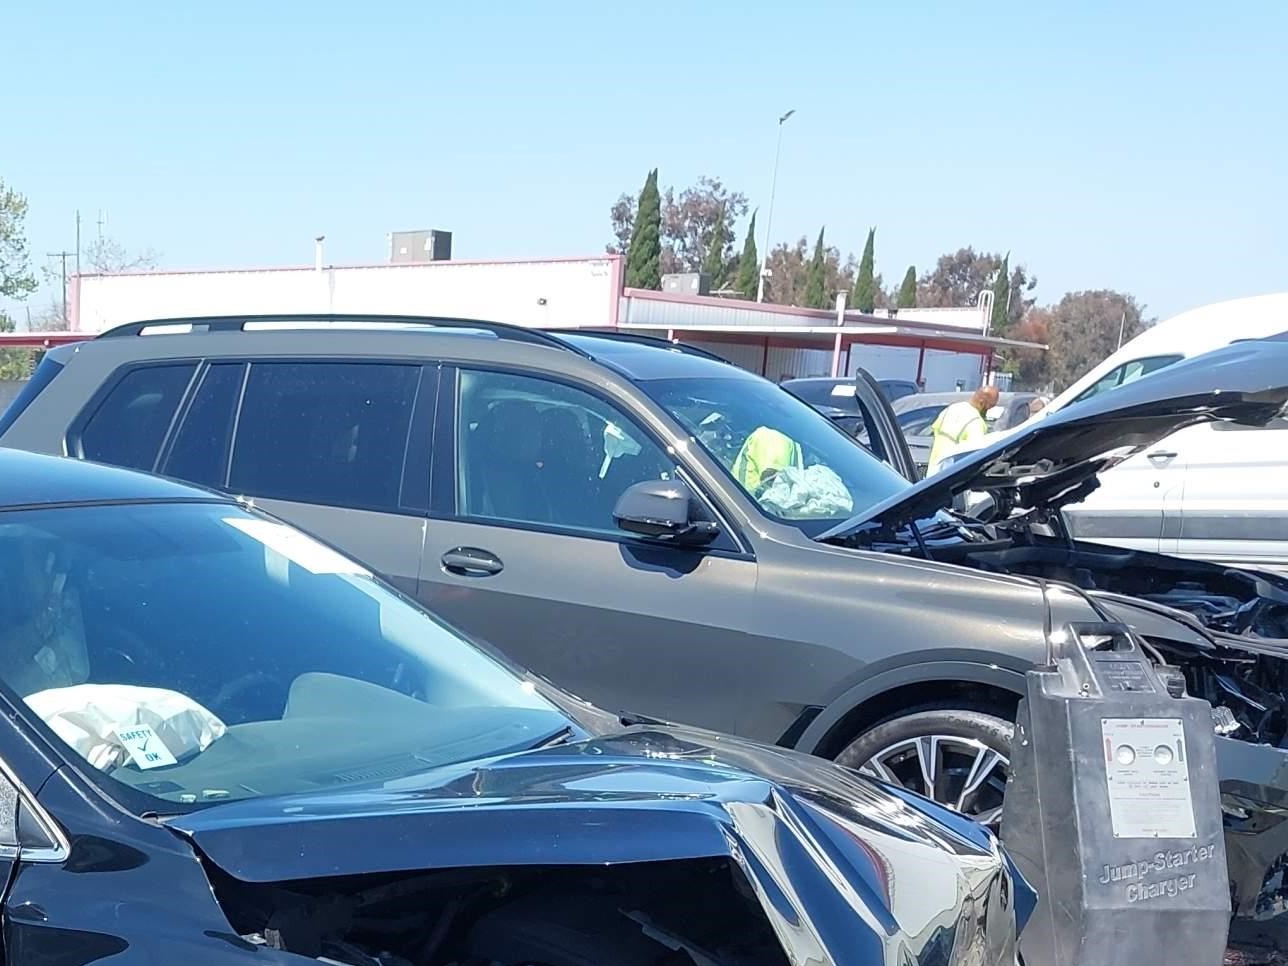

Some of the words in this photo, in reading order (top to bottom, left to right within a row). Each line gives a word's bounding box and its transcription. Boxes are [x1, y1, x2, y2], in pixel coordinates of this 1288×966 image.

[119, 729, 153, 742] SAFETY
[144, 751, 161, 761] OK
[1098, 844, 1215, 884] Jump-Starter
[1126, 873, 1197, 903] Charger
